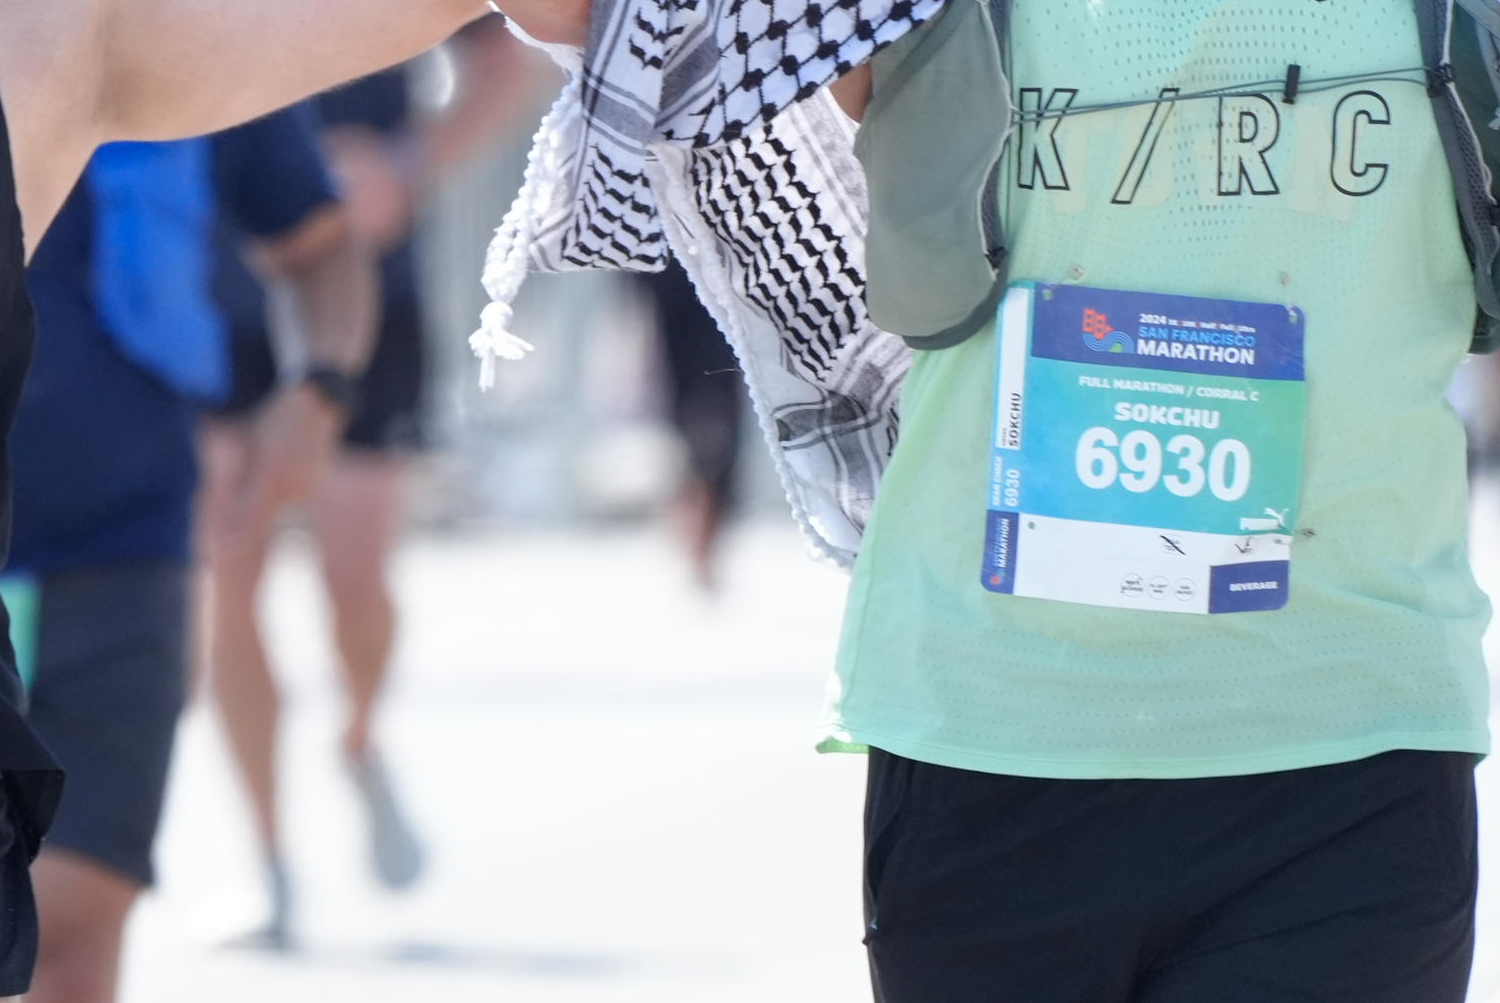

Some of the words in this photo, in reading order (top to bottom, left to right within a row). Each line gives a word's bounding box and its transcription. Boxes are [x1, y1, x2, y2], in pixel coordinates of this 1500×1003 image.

[1138, 313, 1167, 325] 2024
[1138, 325, 1169, 340] SAN
[1171, 328, 1256, 347] FRANCISCO
[1136, 338, 1255, 366] MARATHON
[1078, 375, 1111, 389] FULL
[1113, 378, 1184, 396] MARATHON
[1196, 386, 1248, 401] CORRAL
[1249, 391, 1260, 402] C
[1008, 392, 1022, 448] SOKCHU
[1114, 401, 1221, 430] SOKCHU
[1075, 426, 1251, 502] 6930
[1003, 469, 1021, 507] 6930
[996, 517, 1010, 568] MARATHON
[1229, 581, 1278, 592] BEVERAGE
